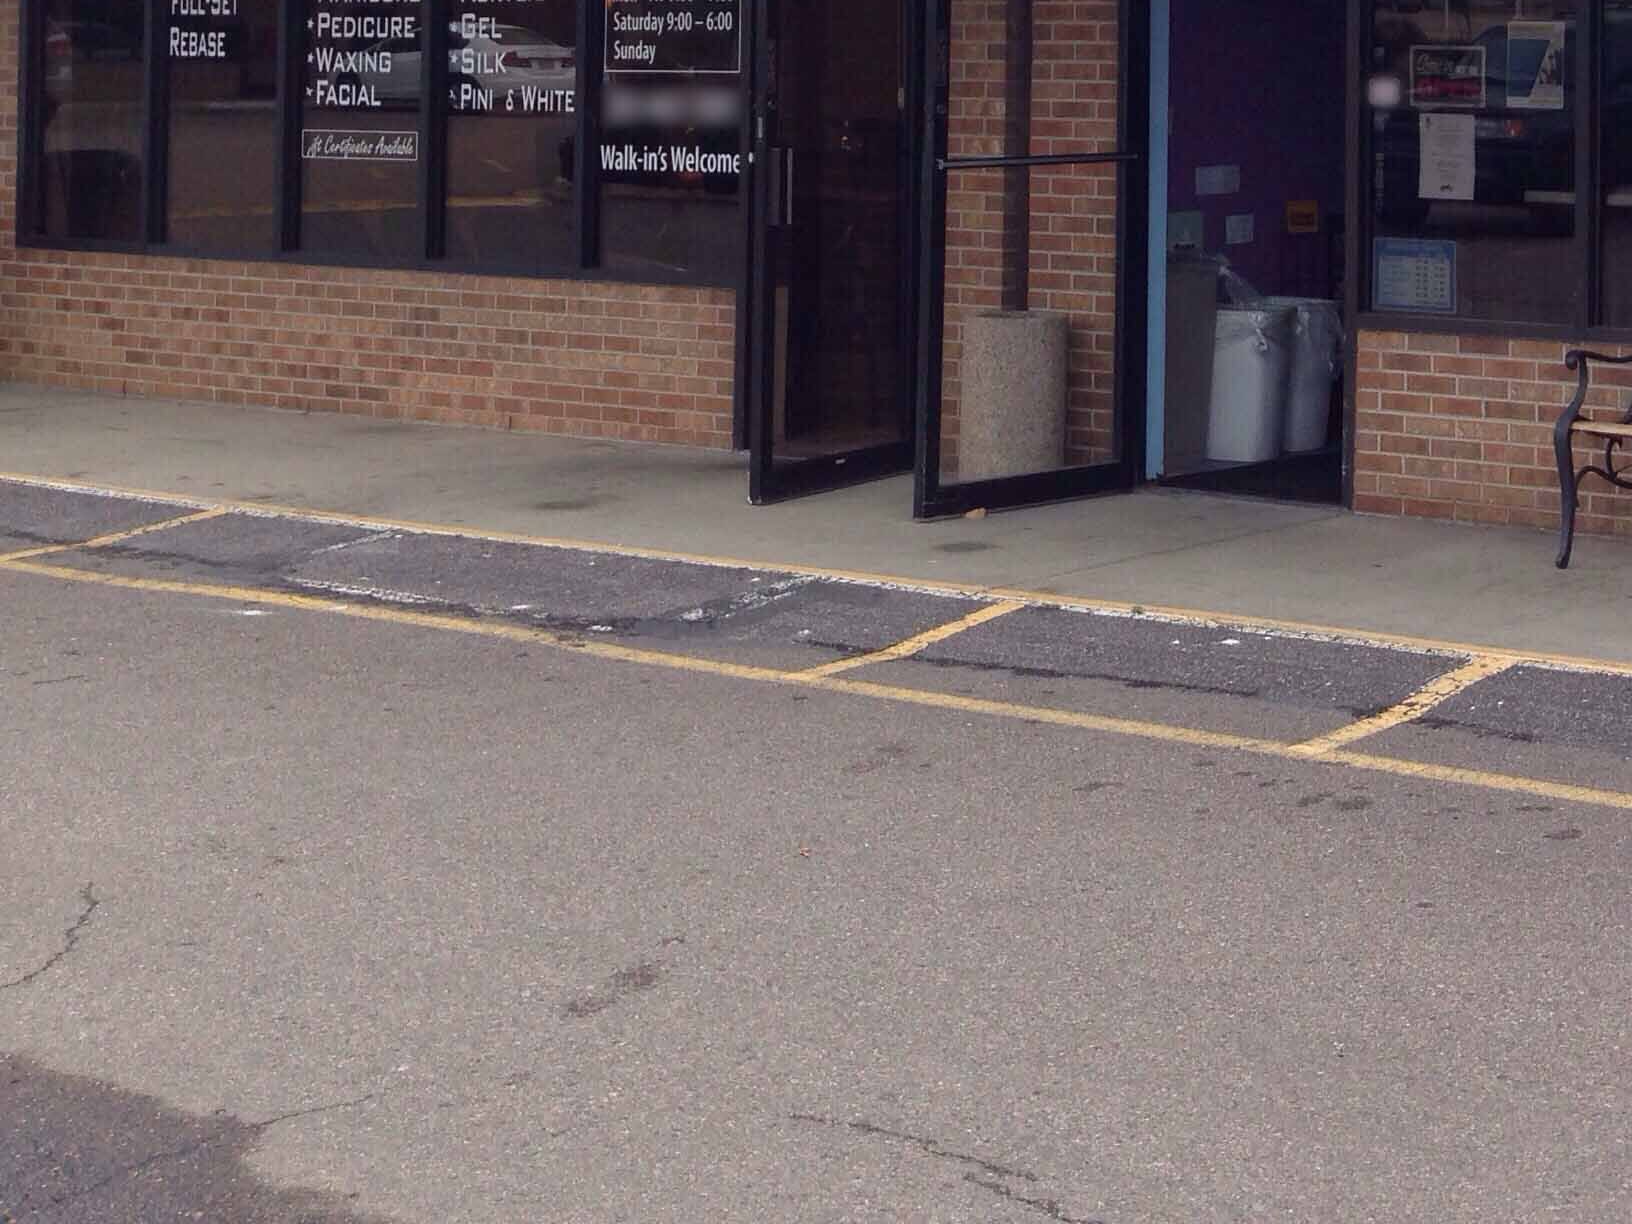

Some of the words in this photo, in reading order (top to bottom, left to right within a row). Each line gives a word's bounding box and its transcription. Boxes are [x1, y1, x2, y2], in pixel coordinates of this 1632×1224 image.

[317, 12, 415, 38] PEDICURE
[462, 13, 502, 39] GEL
[613, 12, 664, 36] Saturday
[667, 12, 692, 31] 9:00
[706, 11, 733, 31] 6:00
[169, 27, 226, 56] REBASE
[613, 40, 656, 64] Sunday
[316, 47, 392, 73] WAXING
[461, 48, 506, 74] SILK
[316, 80, 381, 106] FACIAL
[521, 85, 575, 112] WHITE
[670, 145, 741, 174] Welcome
